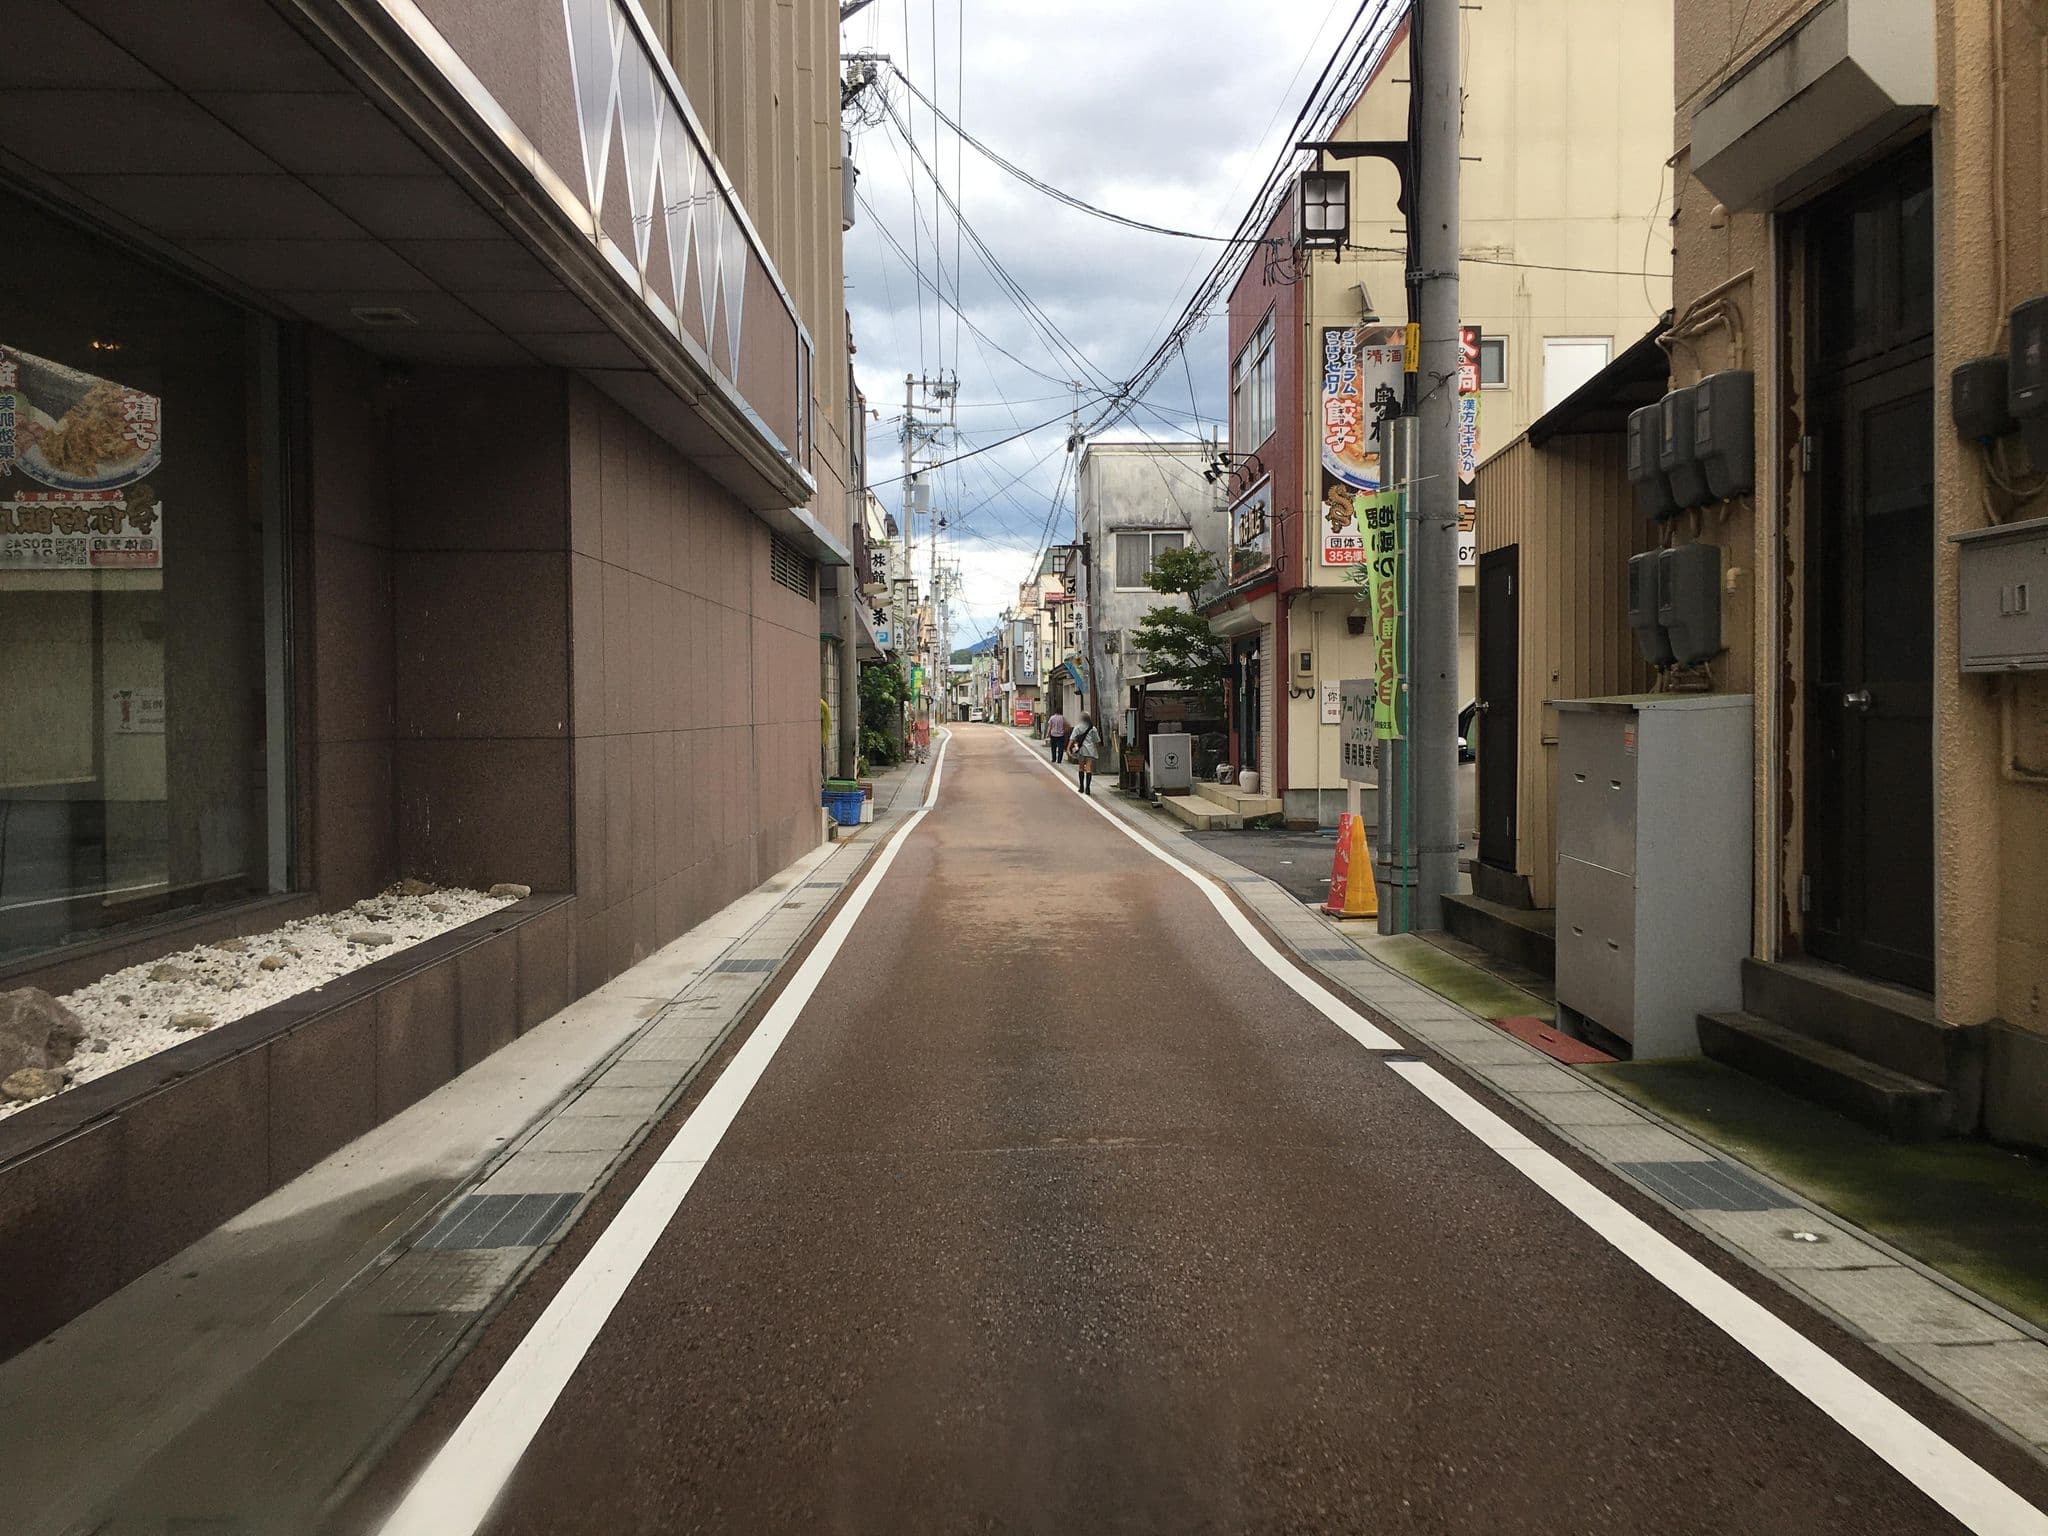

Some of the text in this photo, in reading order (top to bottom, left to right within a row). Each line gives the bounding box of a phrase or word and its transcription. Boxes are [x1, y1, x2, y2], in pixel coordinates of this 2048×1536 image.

[1342, 331, 1358, 396] ジューシーラム
[1366, 349, 1402, 369] 清酒
[1325, 398, 1357, 454] 餃子
[1463, 399, 1476, 471] 漢方エキスが
